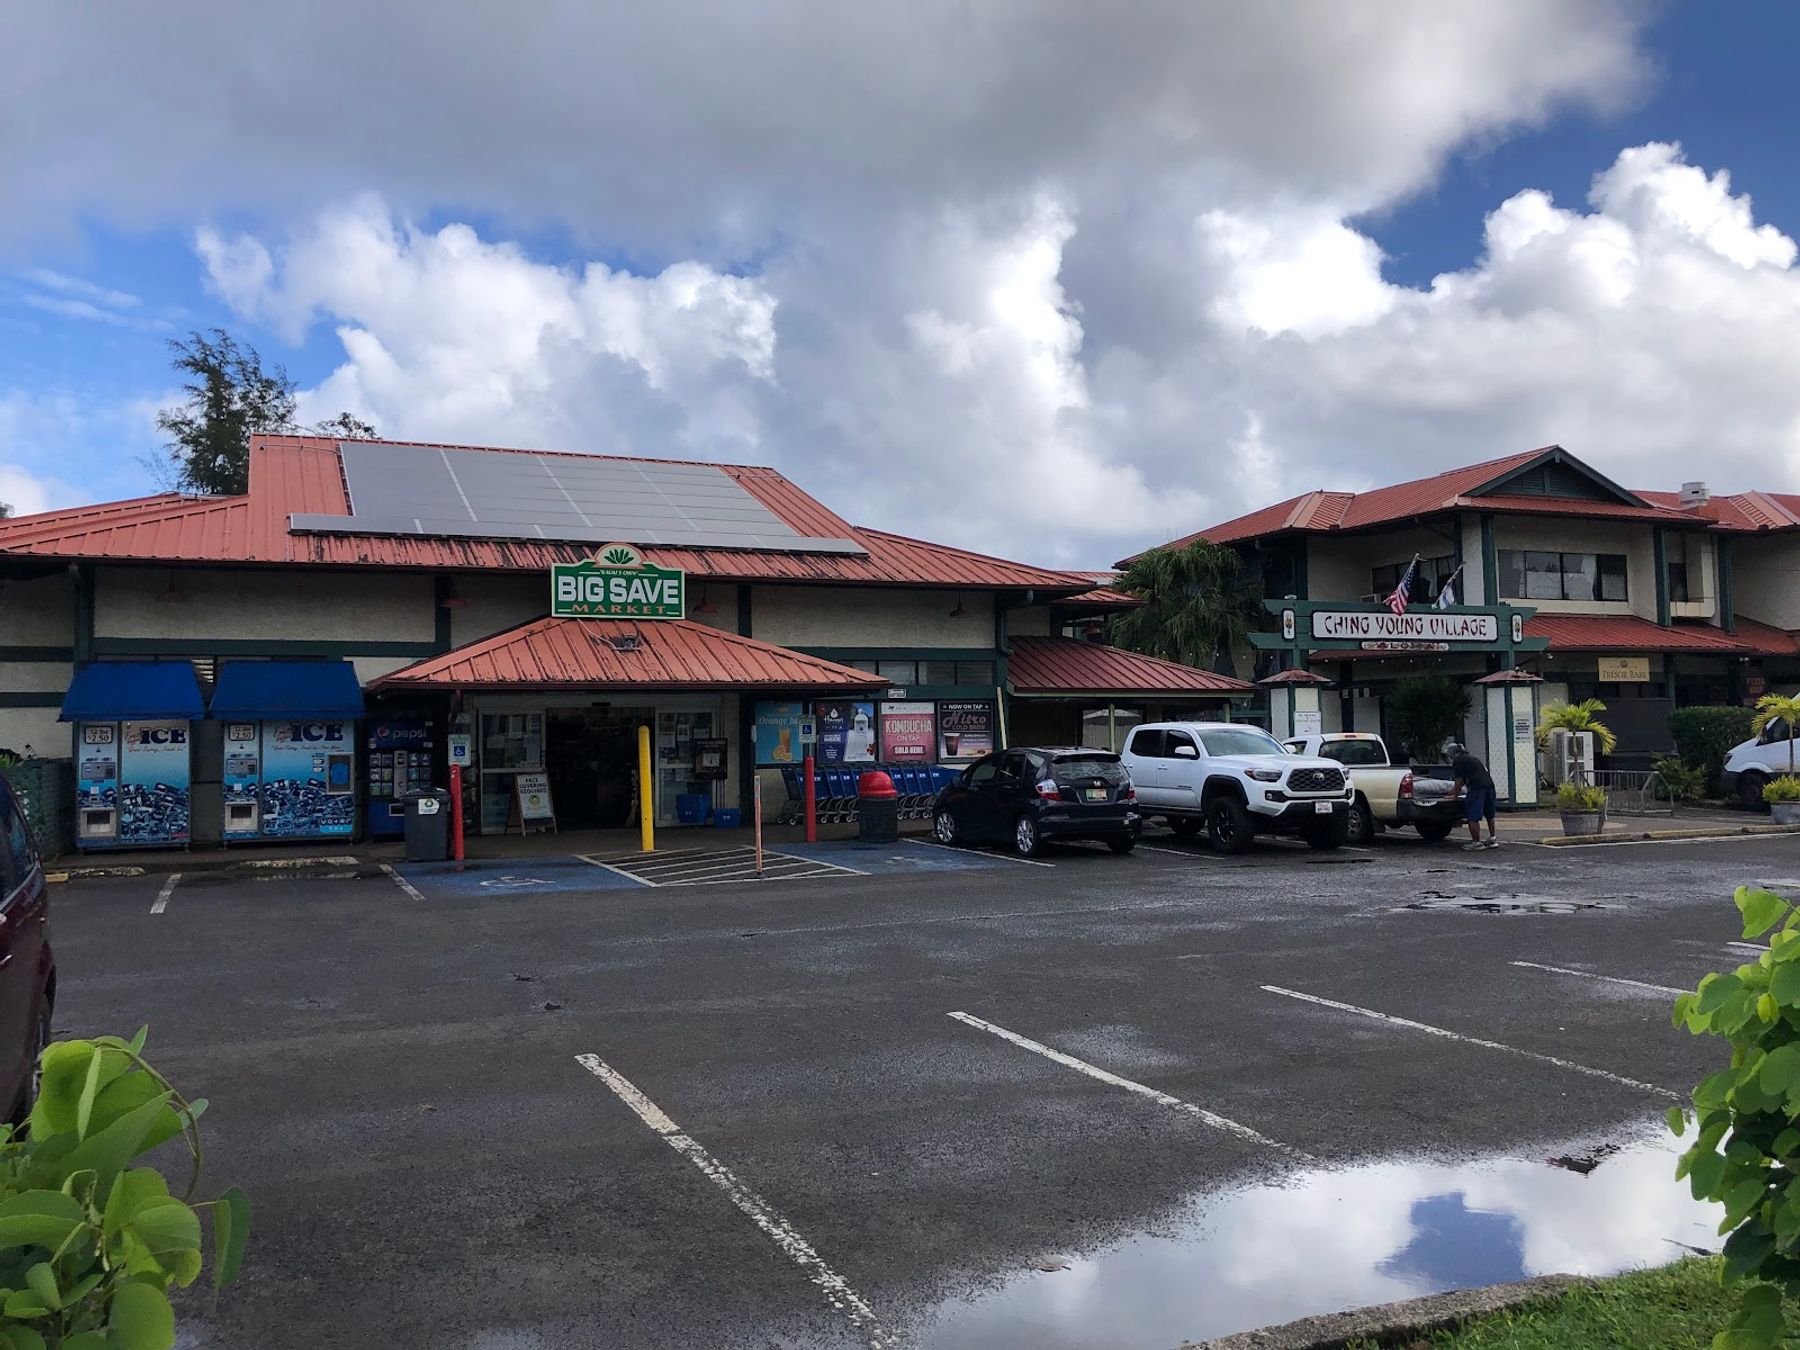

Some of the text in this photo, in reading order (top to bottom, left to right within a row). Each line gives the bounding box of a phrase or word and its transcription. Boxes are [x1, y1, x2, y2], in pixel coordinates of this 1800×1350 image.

[558, 576, 679, 605] BIG SAVE
[571, 604, 666, 615] MARKET
[1325, 615, 1487, 637] CHING YOUNG VILLAGE
[759, 717, 788, 726] Orange
[885, 720, 933, 734] KOMBUCHA
[942, 710, 987, 728] Nitro
[140, 726, 186, 744] ICE
[291, 722, 345, 742] ICE
[392, 729, 427, 740] pepsi
